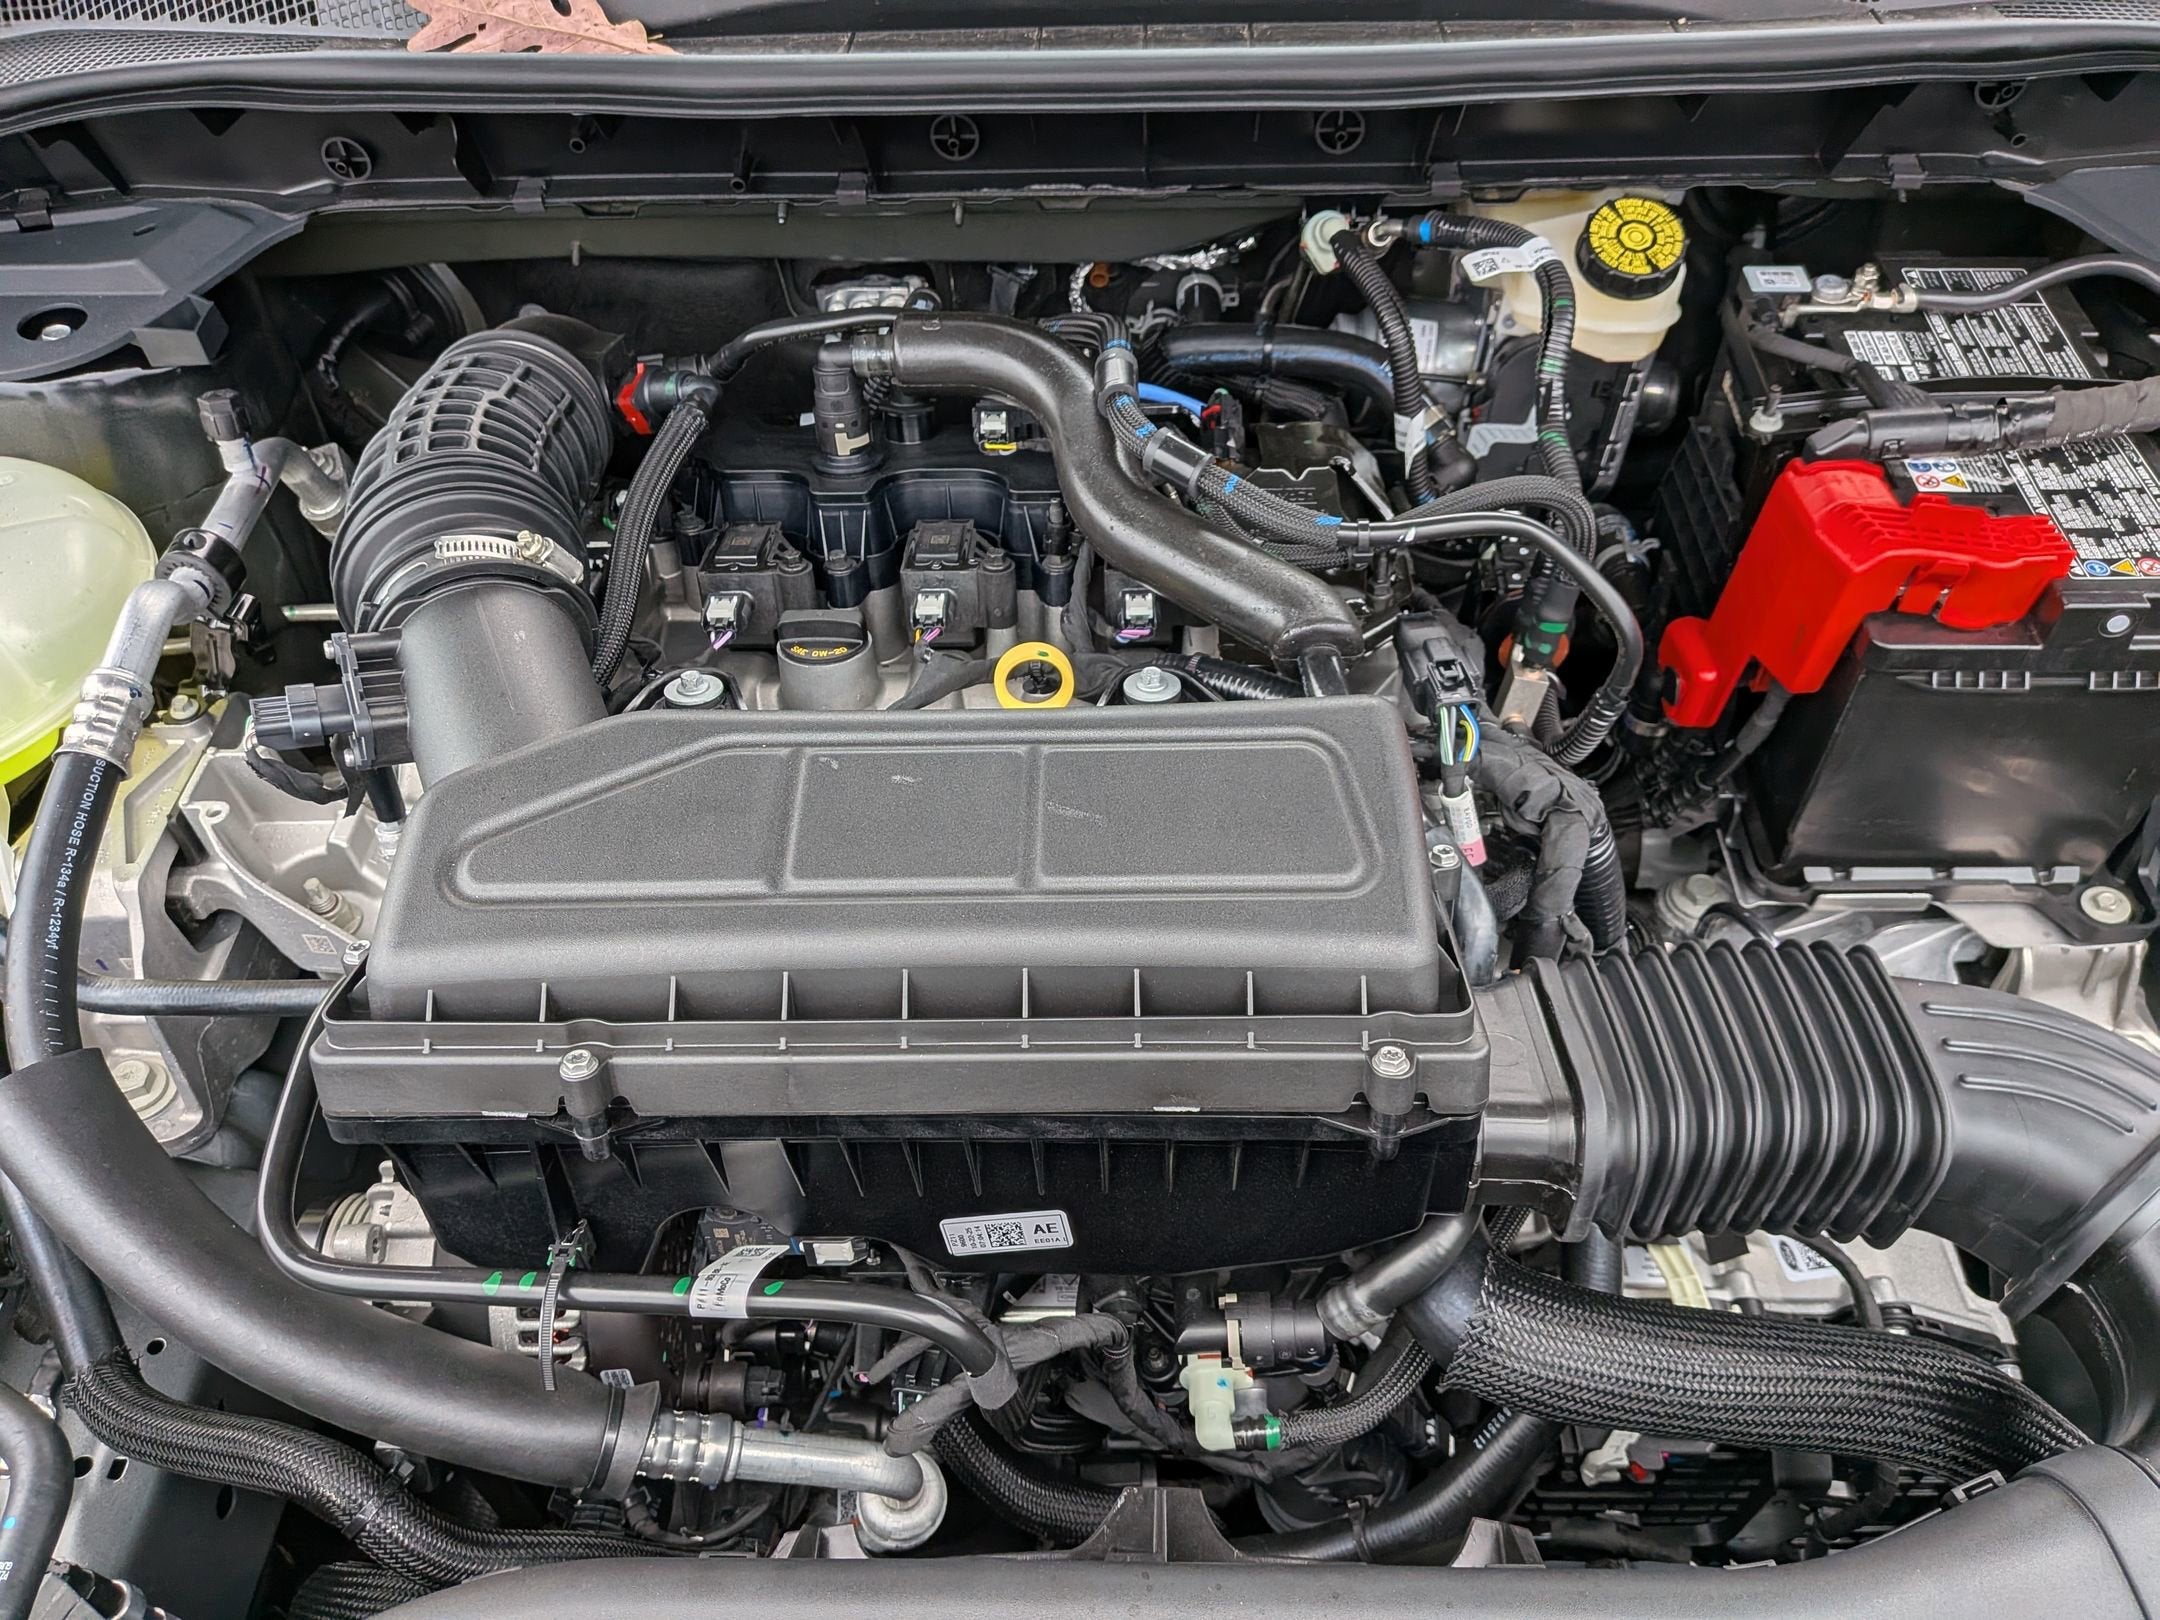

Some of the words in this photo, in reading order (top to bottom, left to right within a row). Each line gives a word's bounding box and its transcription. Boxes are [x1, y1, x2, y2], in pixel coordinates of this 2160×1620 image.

[790, 645, 809, 656] SAE
[811, 646, 848, 657] 0W-20
[79, 758, 106, 811] SUCTION
[68, 811, 88, 846] HOSE
[56, 847, 78, 888] R-134a
[44, 897, 66, 951] R-1234yf
[1033, 1222, 1059, 1235] AE
[712, 1277, 731, 1307] FoMoCo
